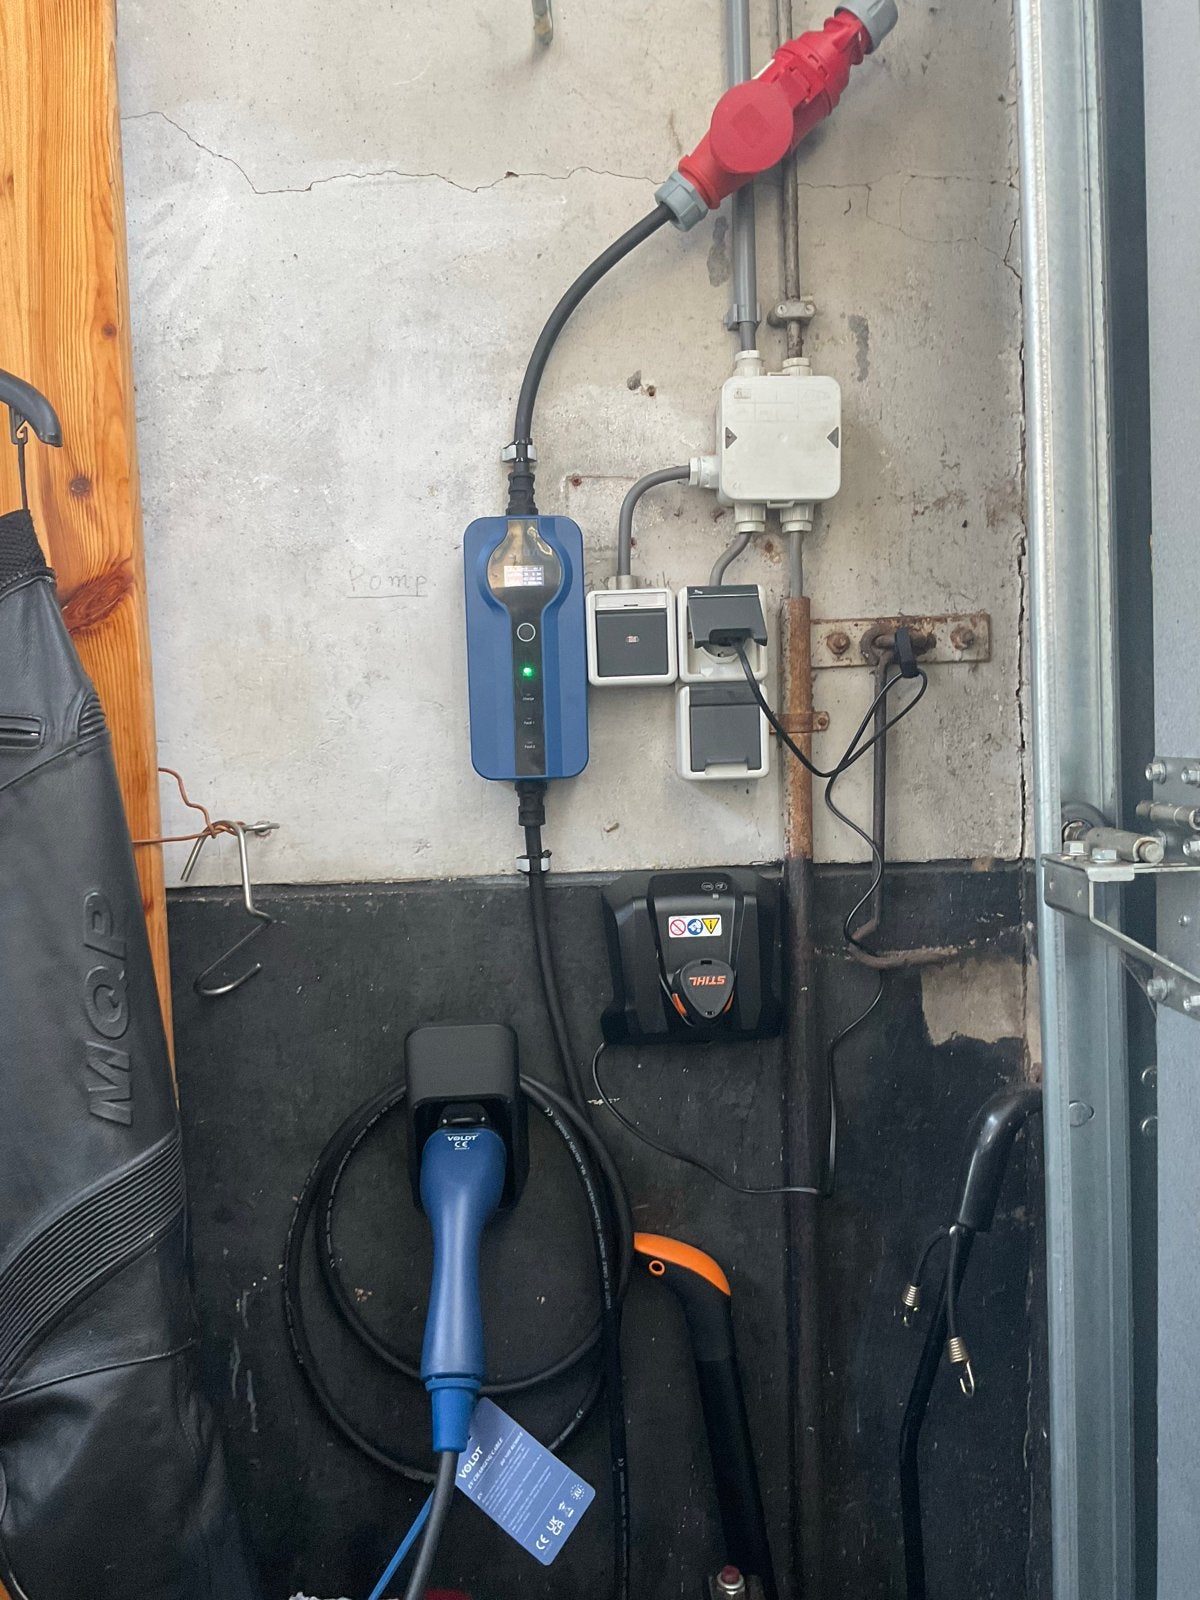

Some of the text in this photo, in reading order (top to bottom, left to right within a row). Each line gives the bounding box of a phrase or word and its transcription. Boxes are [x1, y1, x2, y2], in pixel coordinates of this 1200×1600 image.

[348, 564, 428, 597] Pomp
[689, 975, 727, 987] STIHL
[83, 888, 133, 1127] MQP
[458, 1445, 484, 1479] VOLDT
[471, 1453, 493, 1482] CHARGING
[491, 1437, 504, 1455] CABLE
[546, 1515, 558, 1531] UK
[536, 1534, 549, 1550] CE
